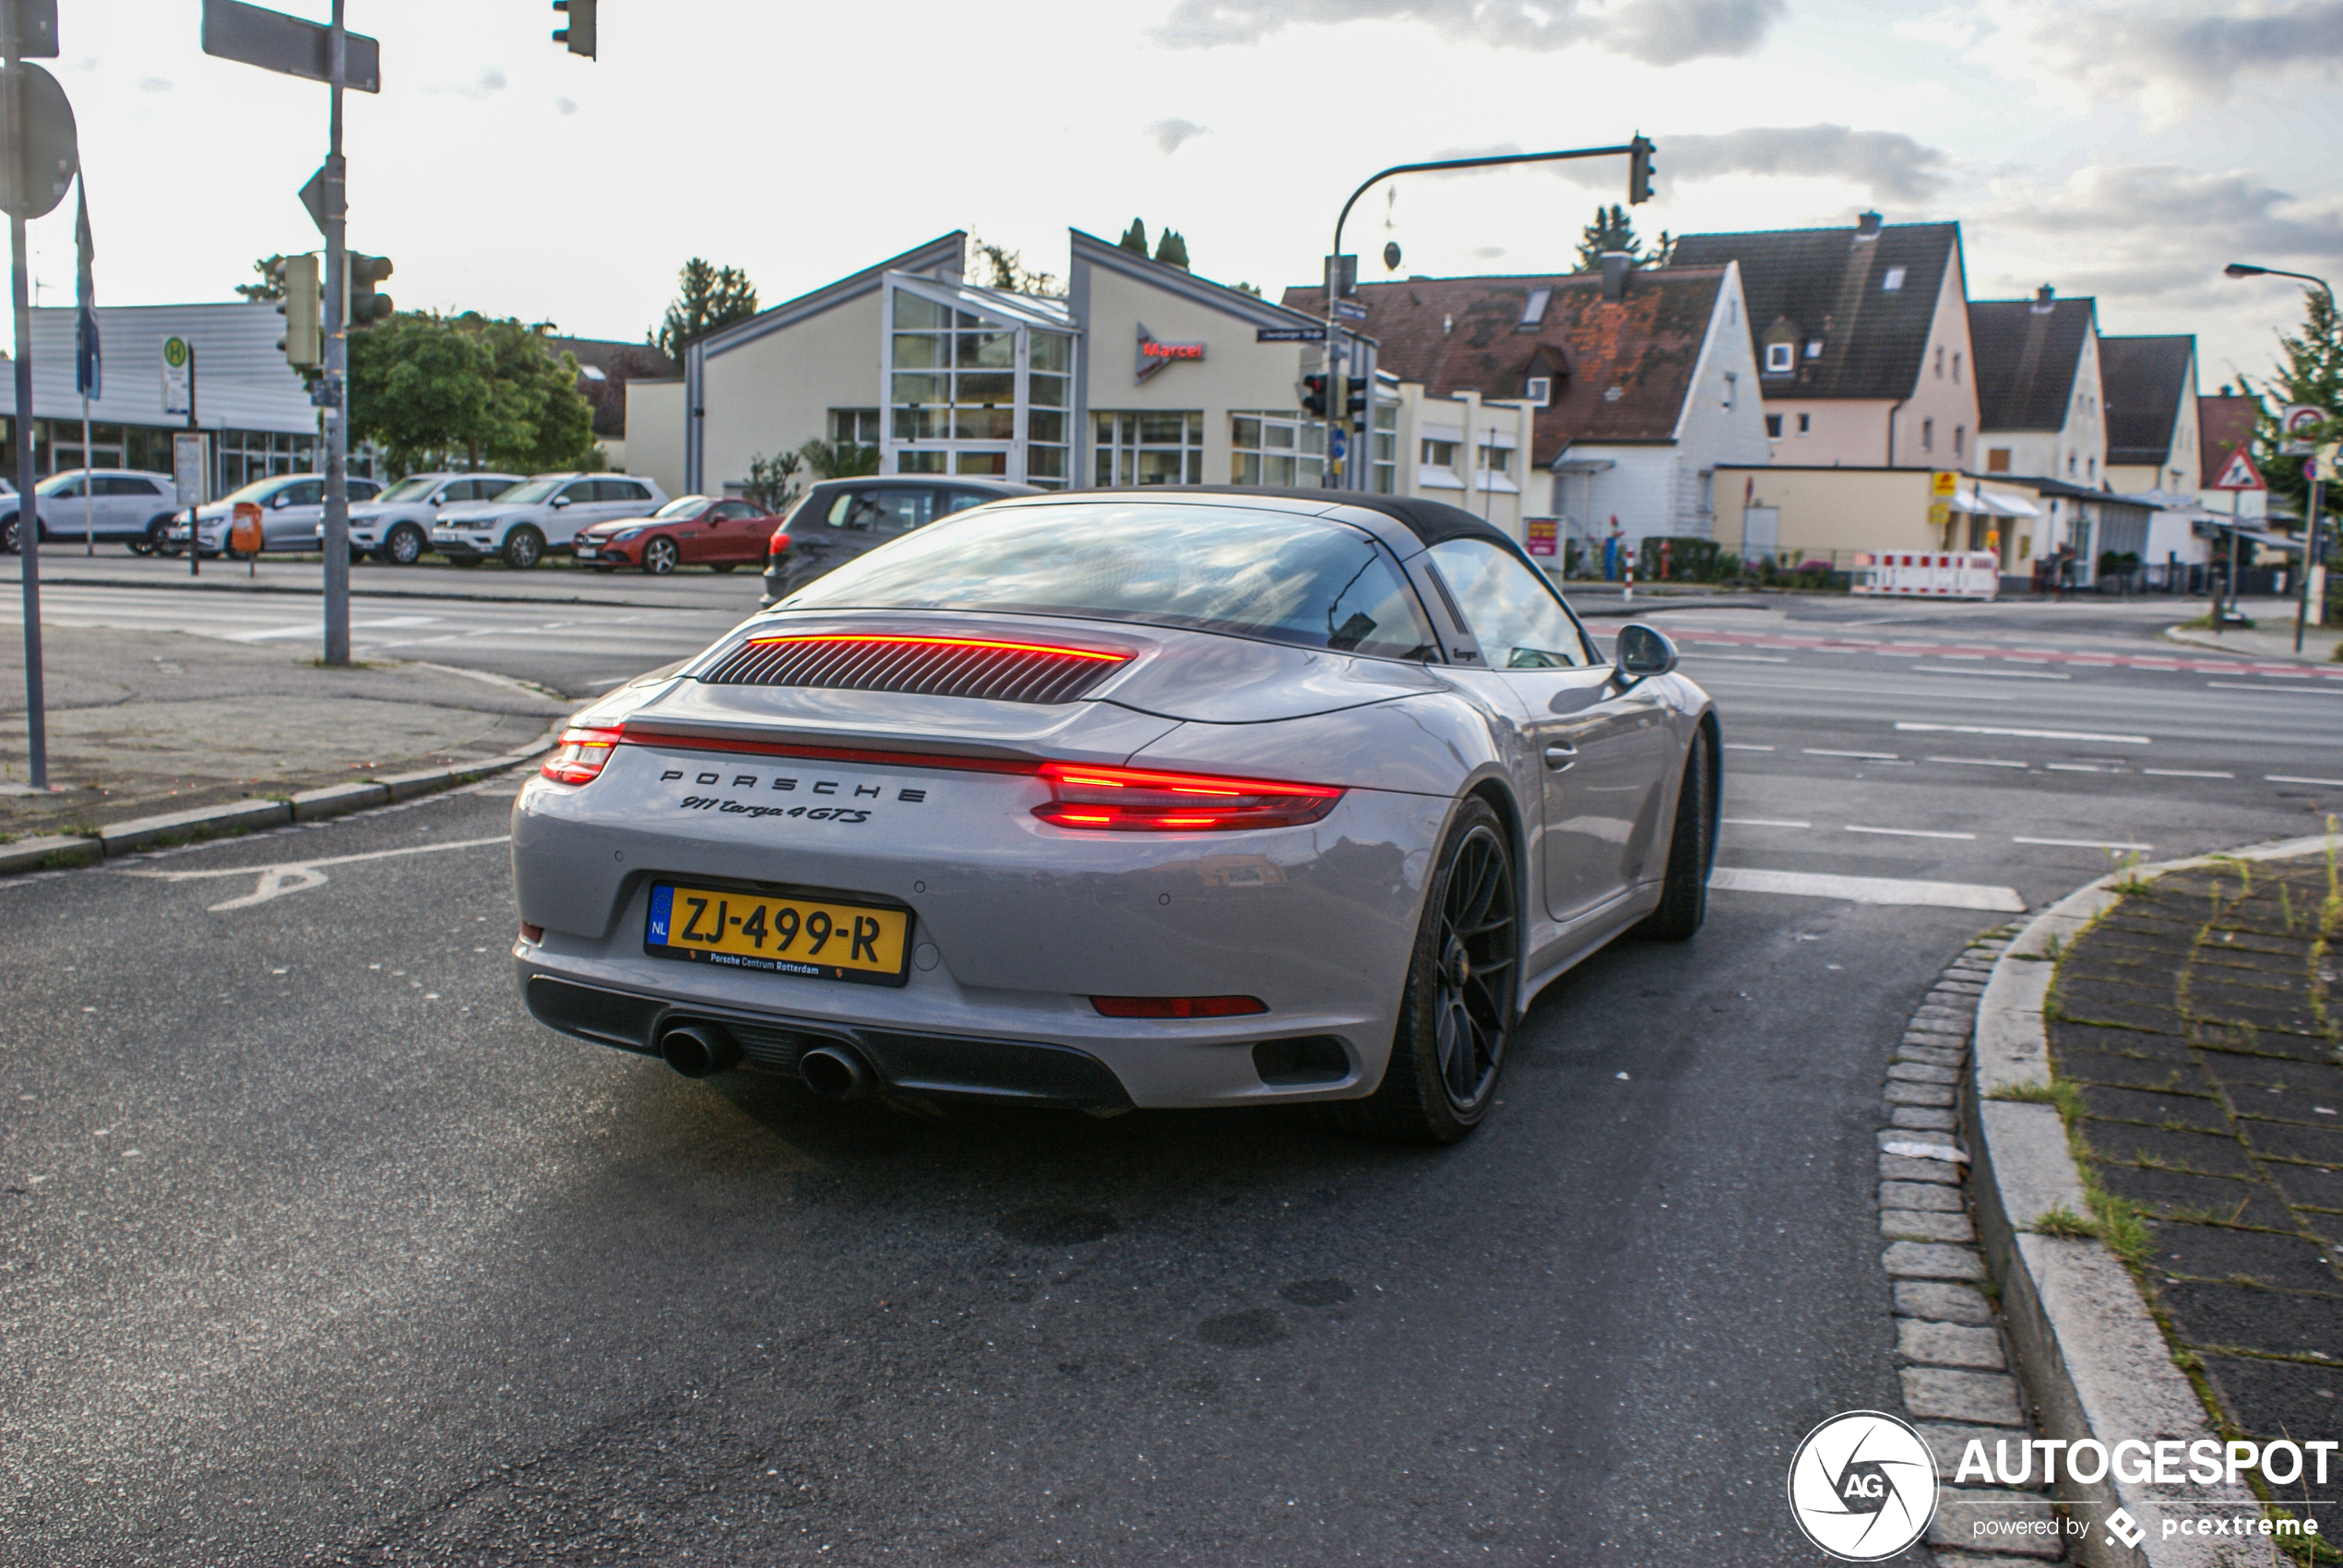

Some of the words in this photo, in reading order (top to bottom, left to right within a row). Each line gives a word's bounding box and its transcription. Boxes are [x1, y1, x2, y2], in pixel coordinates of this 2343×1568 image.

[1143, 342, 1203, 358] Marcel
[660, 770, 926, 802] PORSCHE
[680, 796, 720, 809] 911
[719, 800, 783, 818] targa
[651, 921, 666, 936] NL
[681, 897, 880, 962] ZJ-499-R
[710, 953, 741, 966] Porsche
[742, 956, 775, 969] Centrum
[776, 961, 819, 975] Rotterdam
